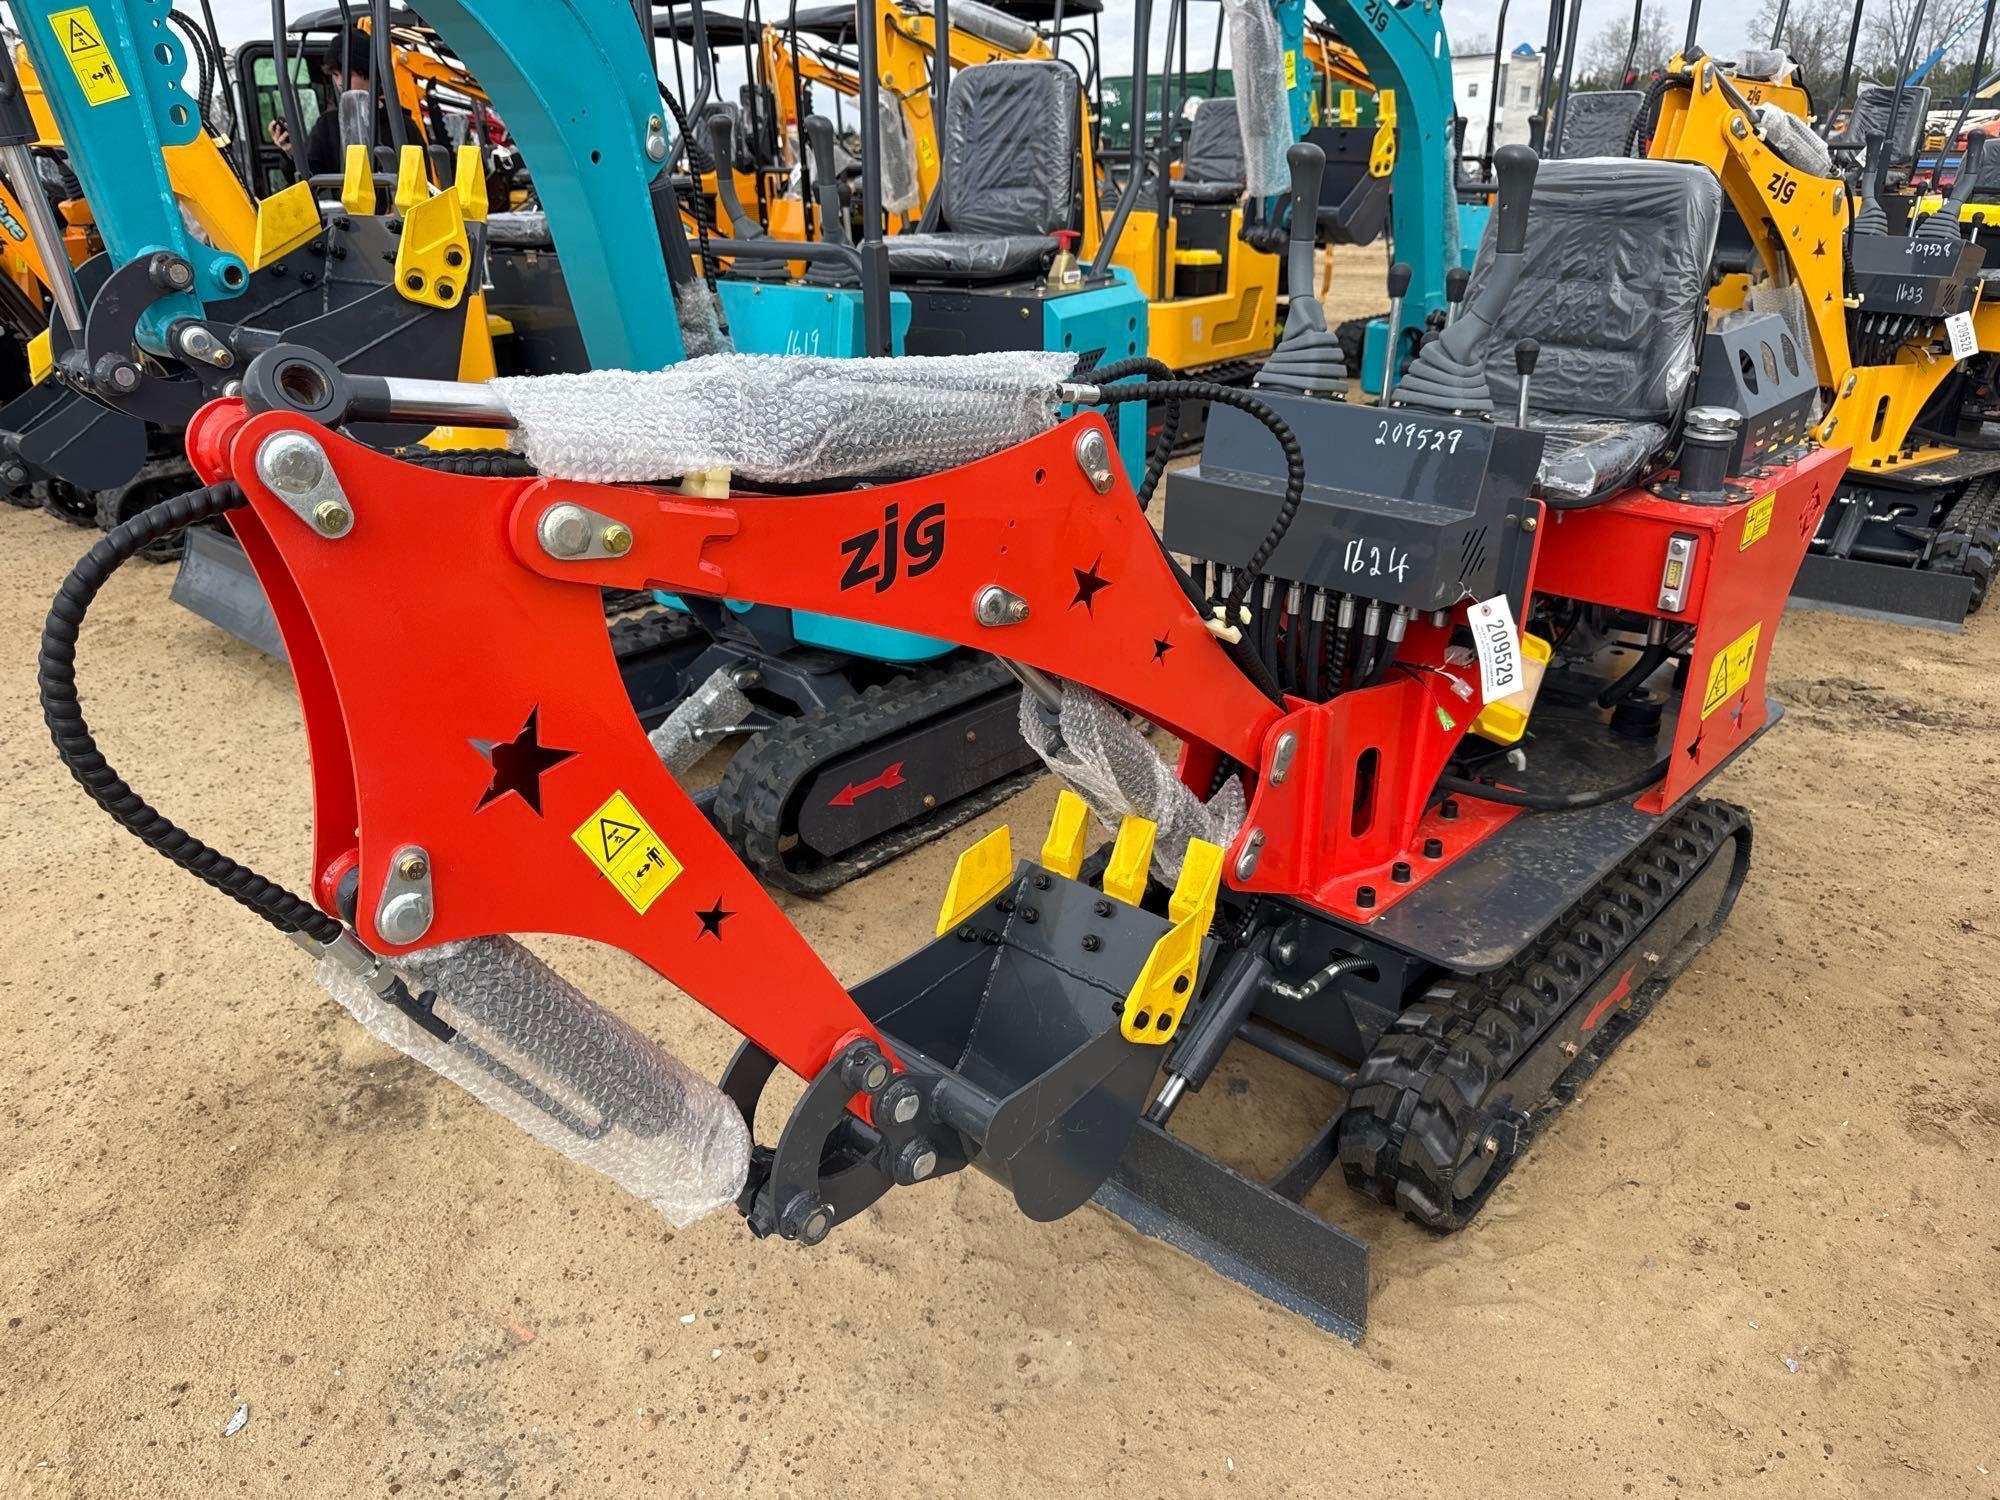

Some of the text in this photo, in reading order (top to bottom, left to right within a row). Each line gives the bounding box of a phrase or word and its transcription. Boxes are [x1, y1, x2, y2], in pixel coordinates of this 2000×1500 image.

[1747, 86, 1761, 105] zjg
[1767, 171, 1797, 204] zjg
[1905, 241, 1953, 257] 209528
[1895, 283, 1923, 304] 1623
[786, 329, 819, 355] 1619
[1375, 420, 1463, 454] 209529
[841, 502, 945, 594] zjg
[1344, 538, 1410, 583] 1624
[1486, 619, 1513, 686] 209529
